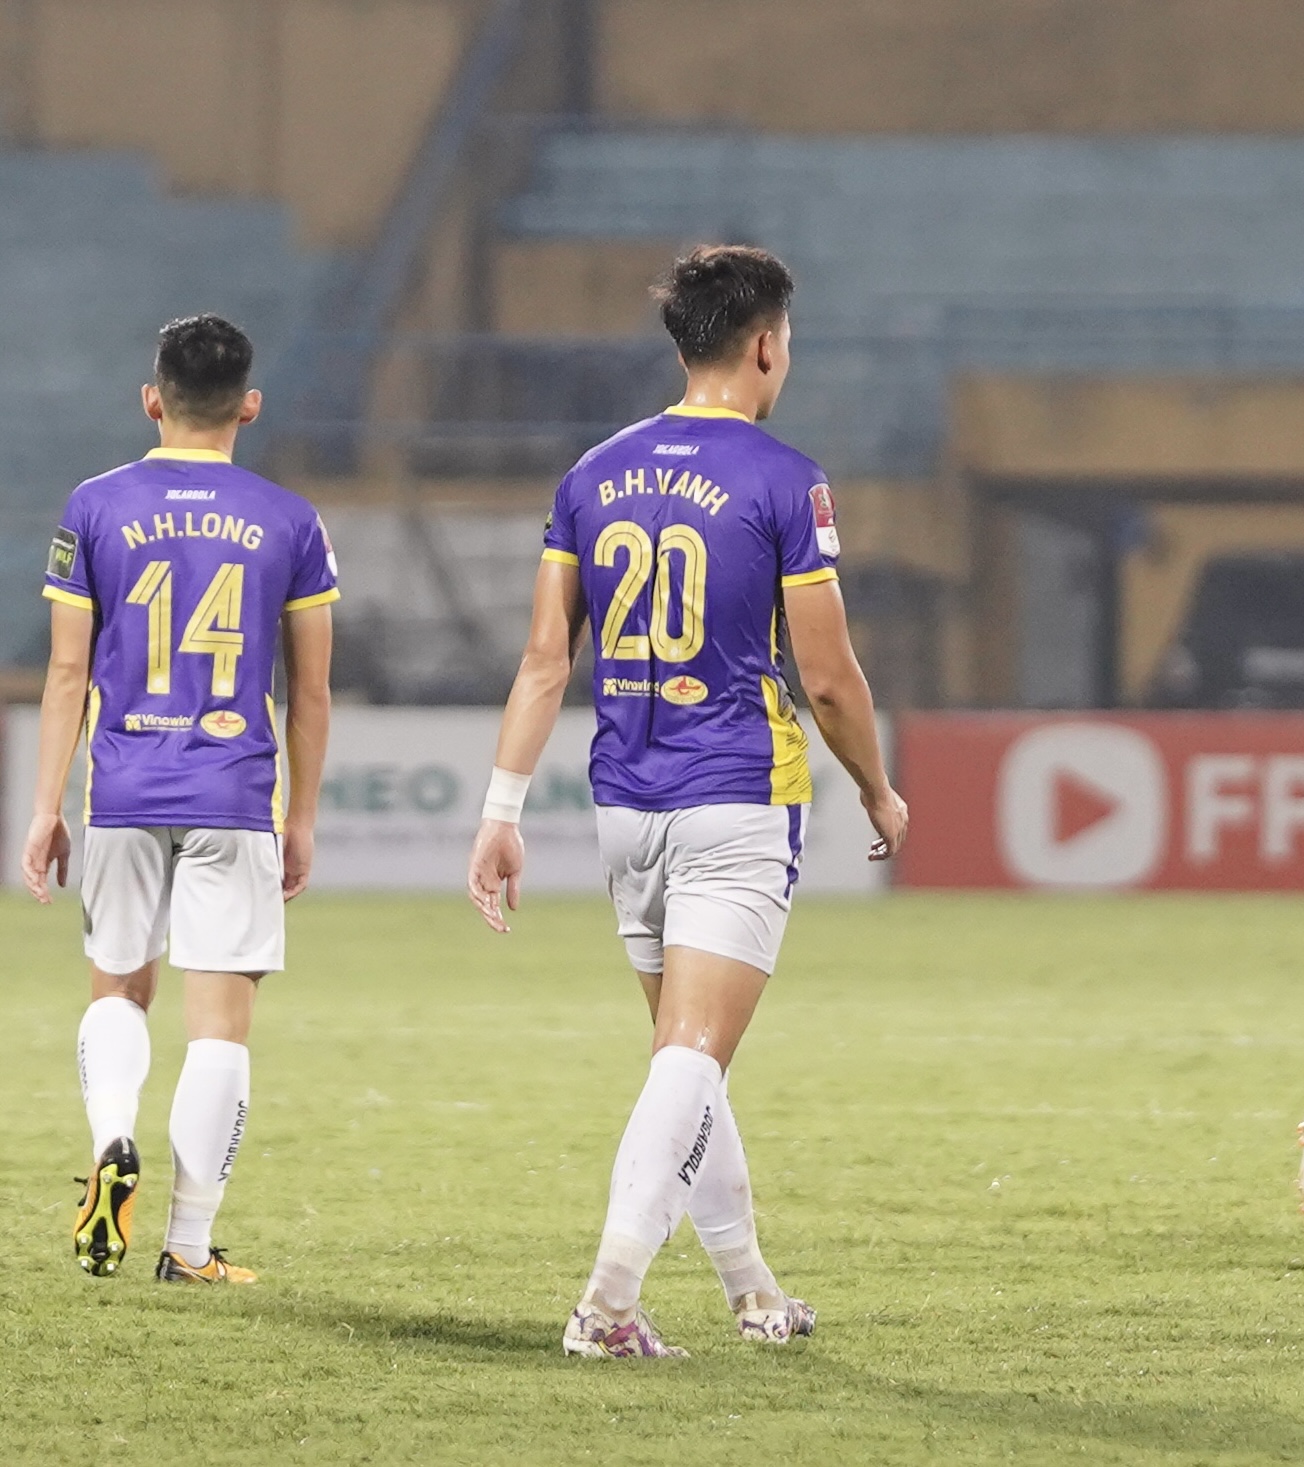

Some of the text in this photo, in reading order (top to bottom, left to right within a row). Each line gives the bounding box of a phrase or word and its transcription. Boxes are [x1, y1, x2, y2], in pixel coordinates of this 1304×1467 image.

[121, 511, 263, 550] N.H.LONG
[125, 560, 245, 697] 14
[593, 520, 708, 663] 20
[677, 1105, 714, 1187] JOGARBOLA
